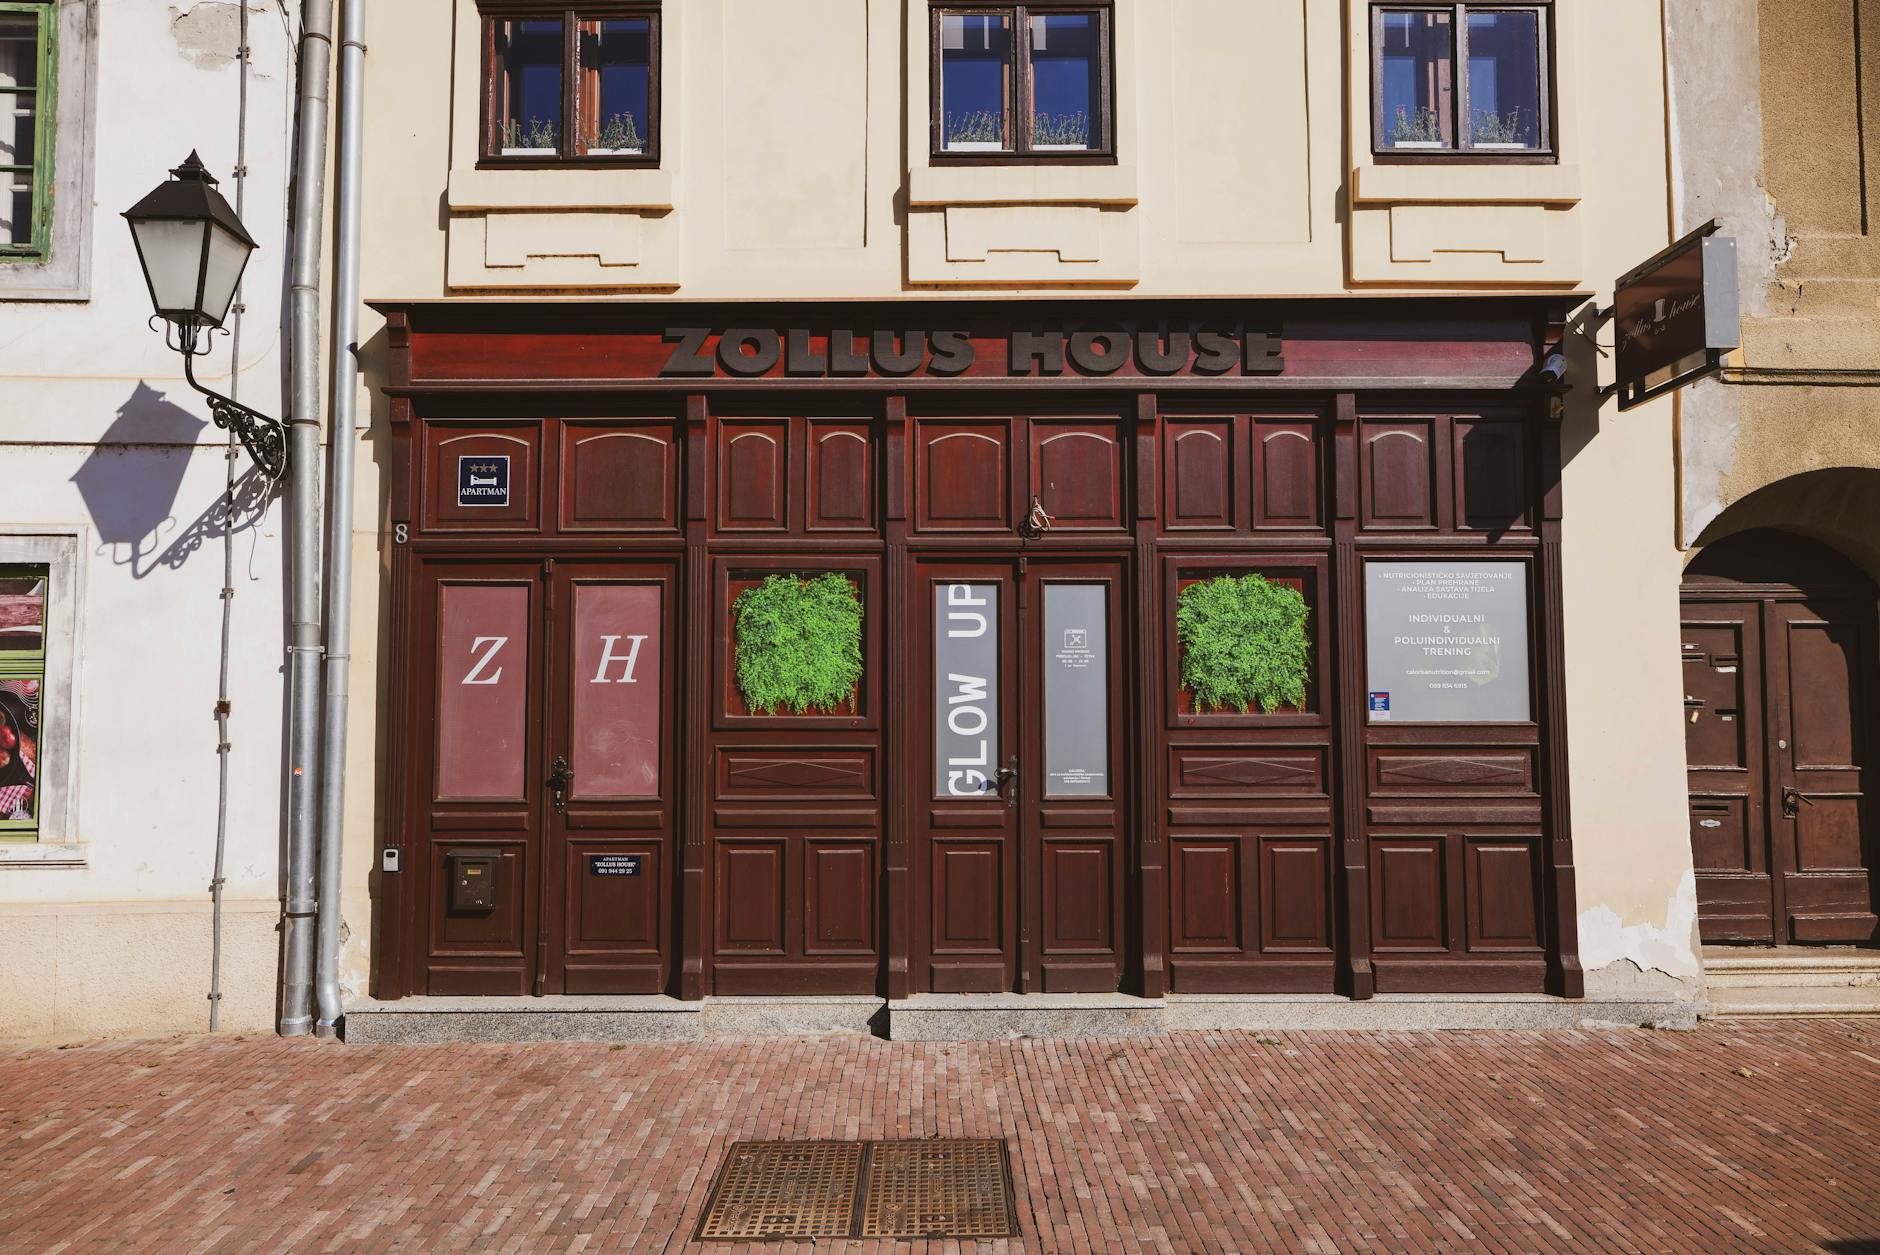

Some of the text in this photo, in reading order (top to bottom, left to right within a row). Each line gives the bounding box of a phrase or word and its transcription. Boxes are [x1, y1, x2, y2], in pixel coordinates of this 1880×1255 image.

[659, 328, 1285, 377] ZOLLUS HOUSE
[460, 487, 507, 496] APARTMAN
[395, 523, 408, 544] 8
[1409, 614, 1485, 623] INDIVIDUALNI
[1443, 626, 1451, 634] &
[1394, 636, 1500, 645] POLUINDIVIDUALNI
[590, 635, 648, 683] H
[1423, 647, 1472, 656] TRENING
[461, 636, 508, 684] Z
[947, 584, 988, 796] GLOW UP
